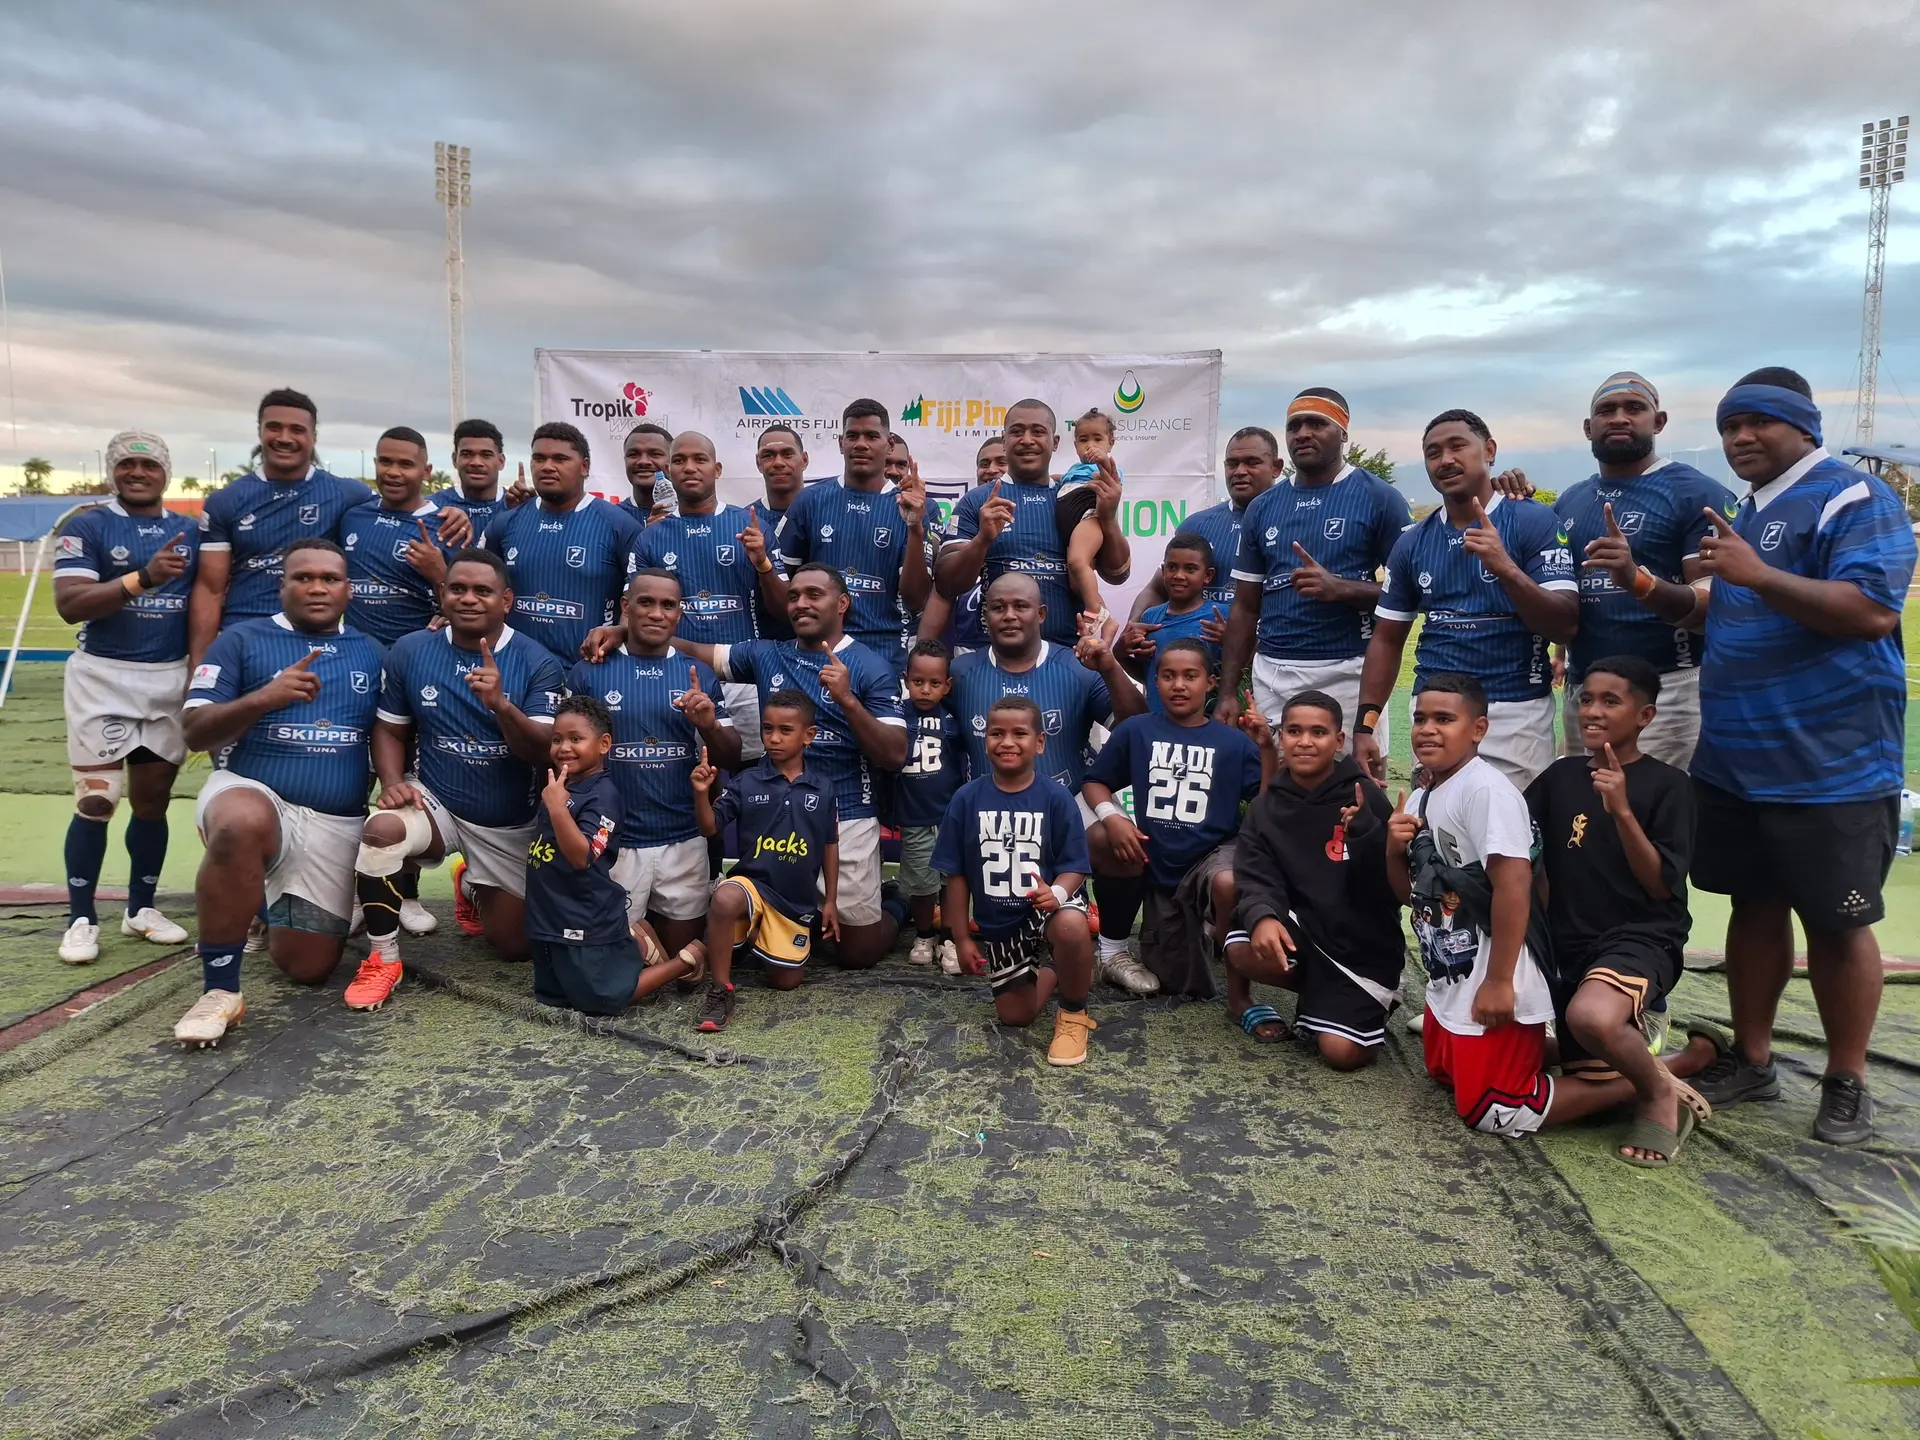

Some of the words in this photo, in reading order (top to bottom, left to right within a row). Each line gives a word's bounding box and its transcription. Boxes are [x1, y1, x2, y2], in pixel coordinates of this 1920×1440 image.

[570, 398, 633, 421] Tropik
[919, 400, 960, 433] Fiji
[965, 400, 1006, 427] Pin
[736, 419, 810, 429] AIRPORTS
[814, 419, 838, 429] FIJI
[735, 432, 839, 440] LITED
[516, 599, 577, 616] SKIPPER
[680, 599, 738, 611] SKIPPER
[530, 616, 554, 624] TUNA
[635, 666, 664, 679] jack's
[1002, 682, 1029, 697] jack's
[277, 727, 358, 742] SKIPPER
[437, 738, 509, 756] SKIPPER
[615, 746, 687, 758] SKIPPER
[1149, 741, 1216, 779] NADI
[755, 794, 770, 802] FIJI
[1146, 767, 1212, 824] 26
[978, 811, 1044, 847] NADI
[980, 841, 1041, 897] 26
